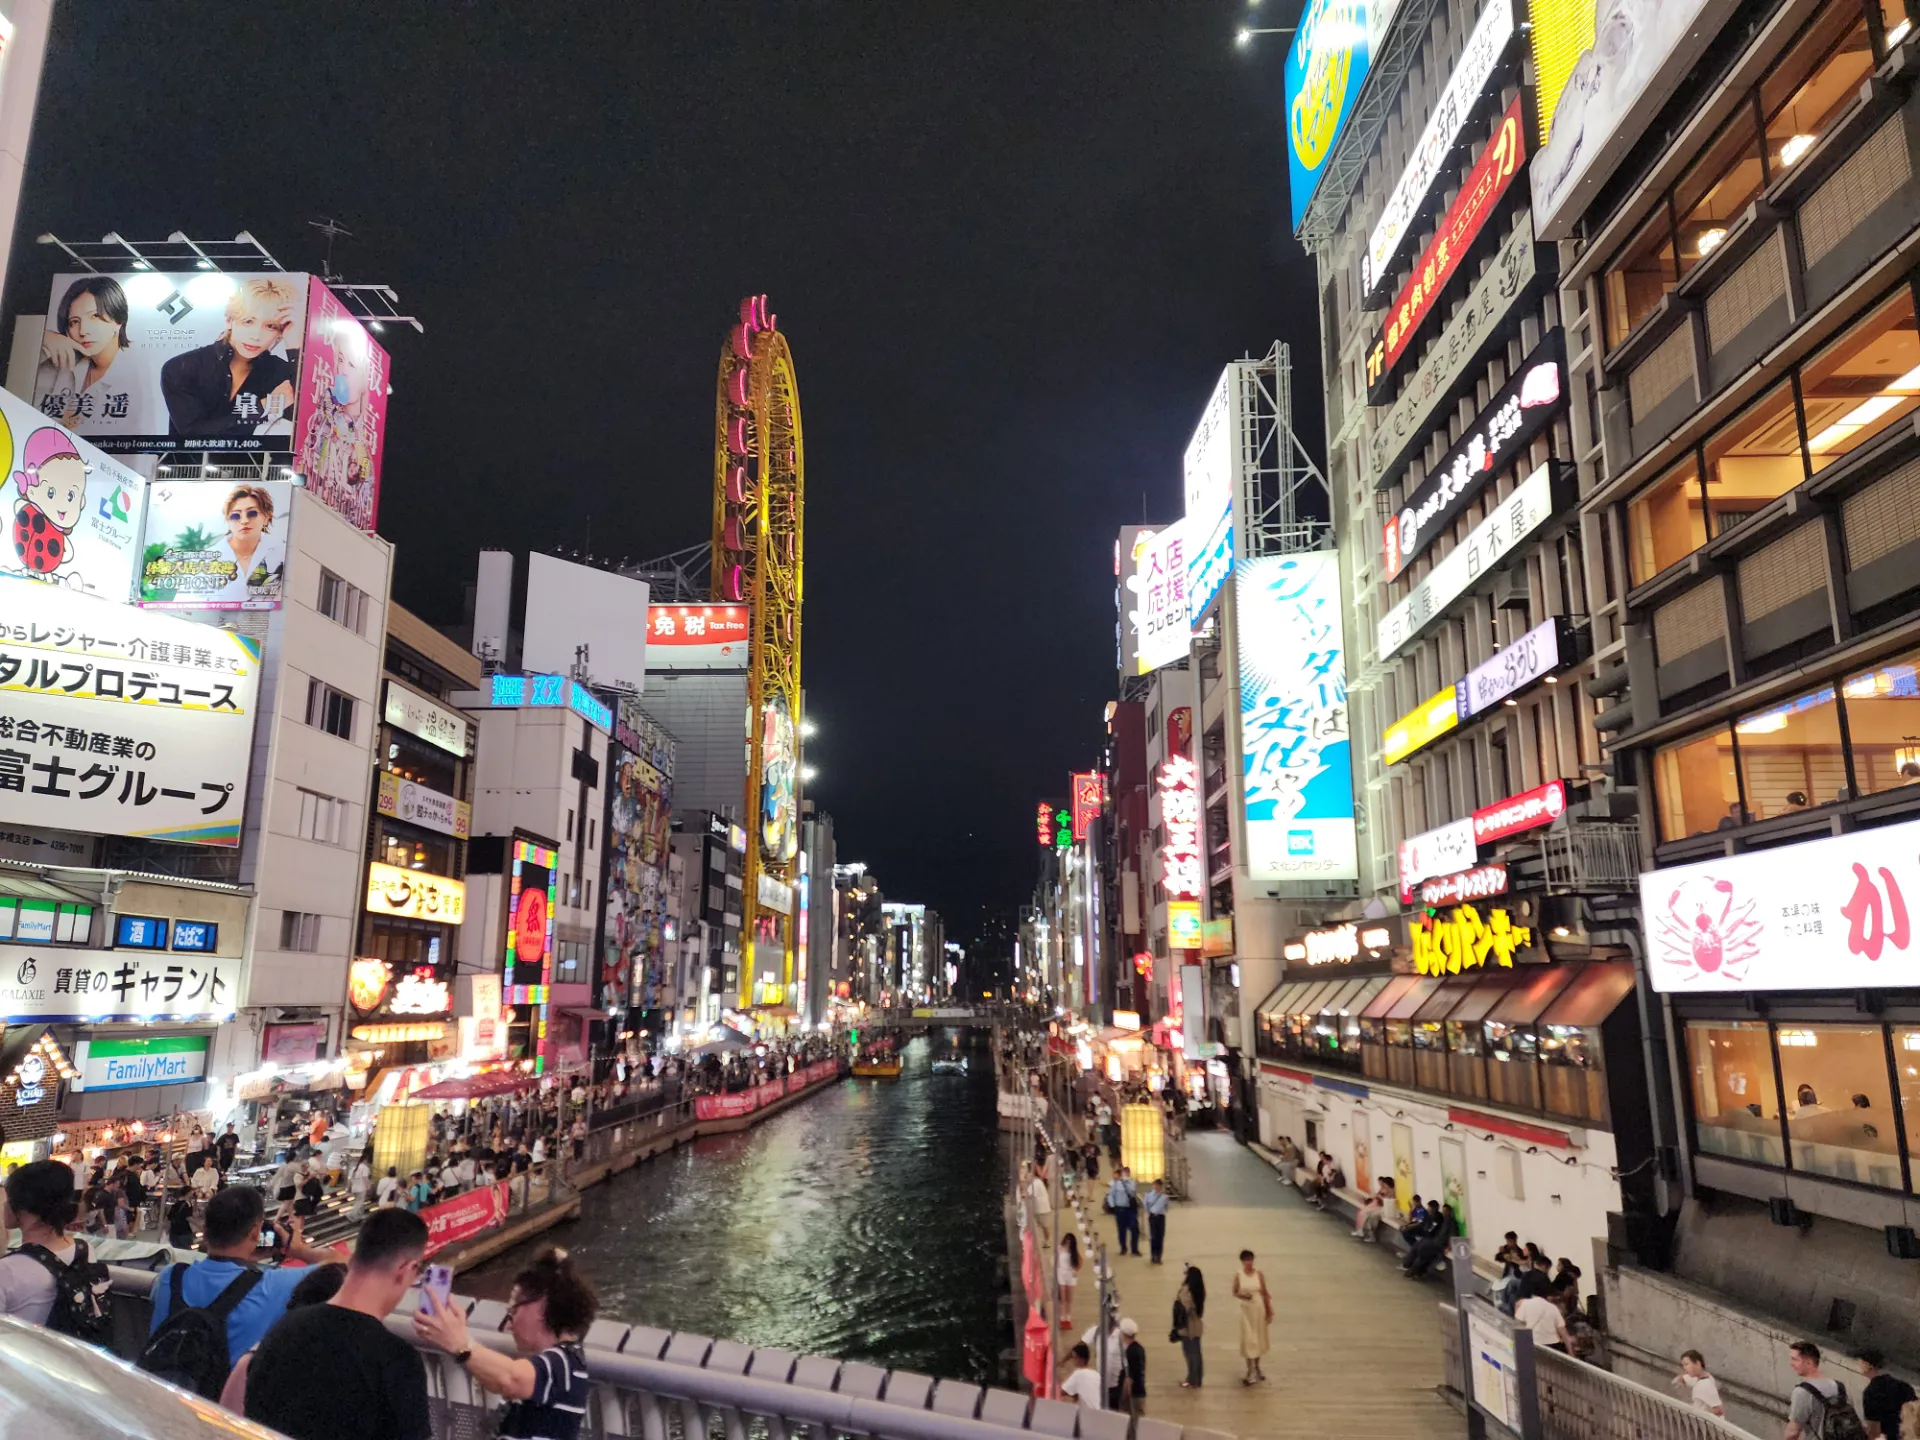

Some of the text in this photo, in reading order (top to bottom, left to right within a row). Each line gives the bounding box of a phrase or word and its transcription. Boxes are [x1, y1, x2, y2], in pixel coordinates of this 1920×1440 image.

[1366, 340, 1385, 387] 7F
[101, 393, 129, 418] 遥
[231, 392, 287, 419] 皐月
[1466, 497, 1526, 580] 白木屋
[653, 615, 705, 636] 免税
[709, 621, 725, 630] Tax
[726, 621, 745, 630] Free
[491, 674, 565, 705] 無双
[1268, 858, 1340, 872] 文化シャッター
[129, 921, 146, 944] 酒
[175, 926, 205, 947] たばこ
[1409, 903, 1532, 977] びっくりドンキー
[53, 961, 226, 1004] 賃貸のギャラント
[107, 1057, 187, 1081] FamilyMart
